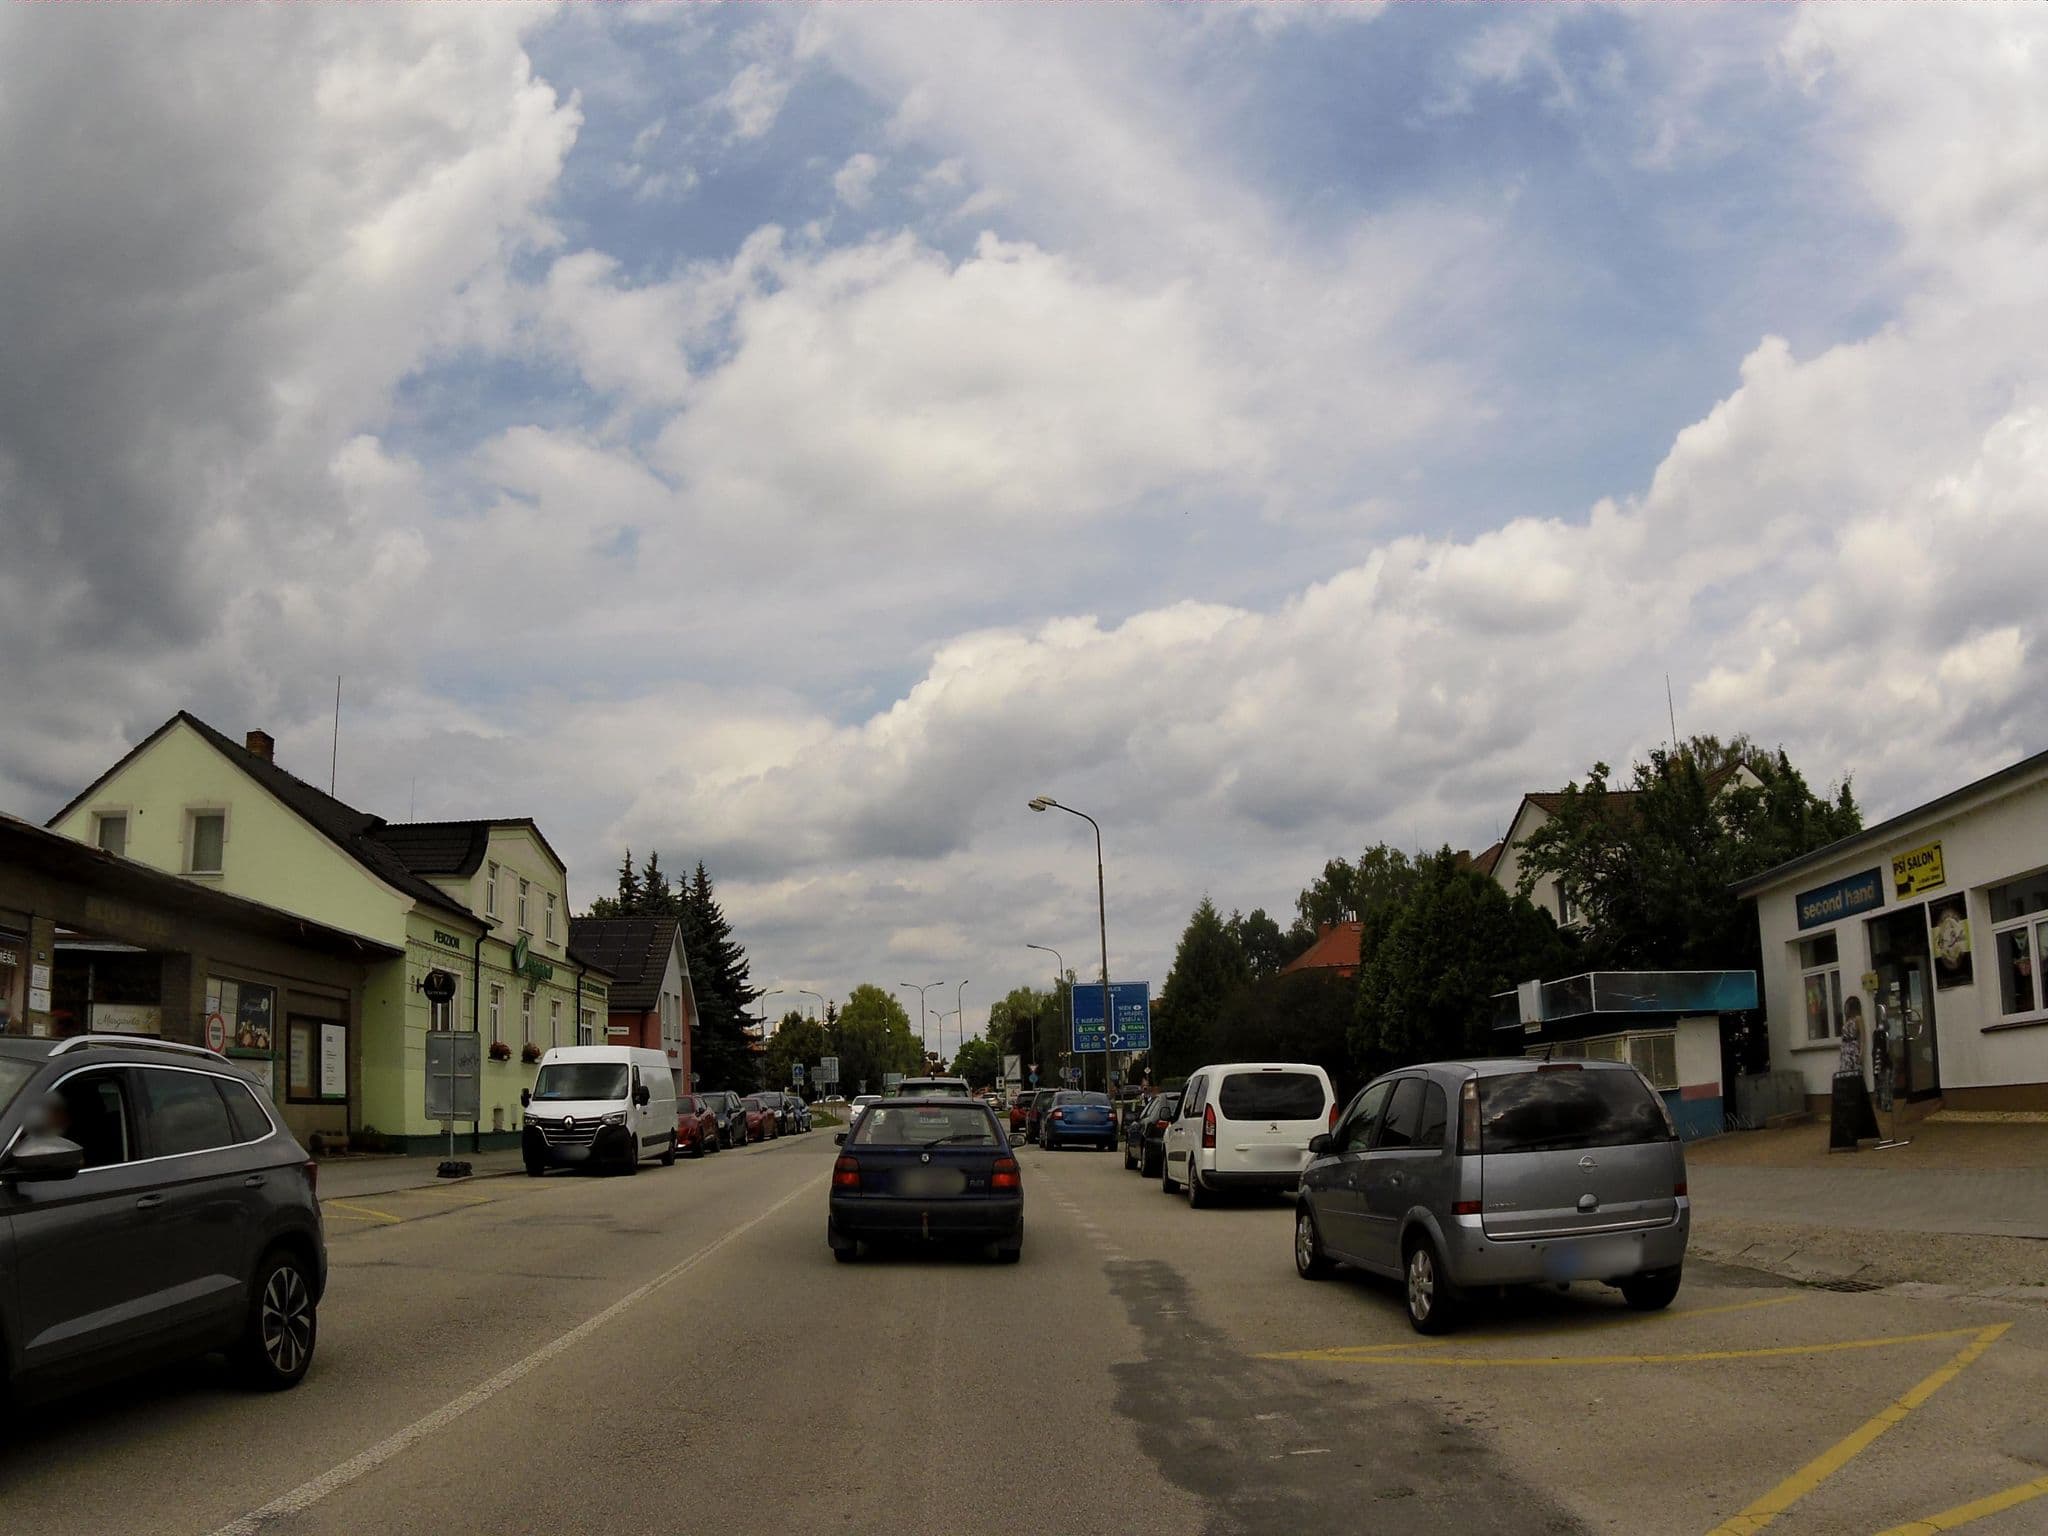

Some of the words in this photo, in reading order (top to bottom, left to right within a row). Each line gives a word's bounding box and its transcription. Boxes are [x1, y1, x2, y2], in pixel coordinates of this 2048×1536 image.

[1907, 850, 1934, 870] SALON
[1803, 890, 1843, 919] second
[1844, 880, 1876, 908] hand
[433, 929, 460, 949] PENZION
